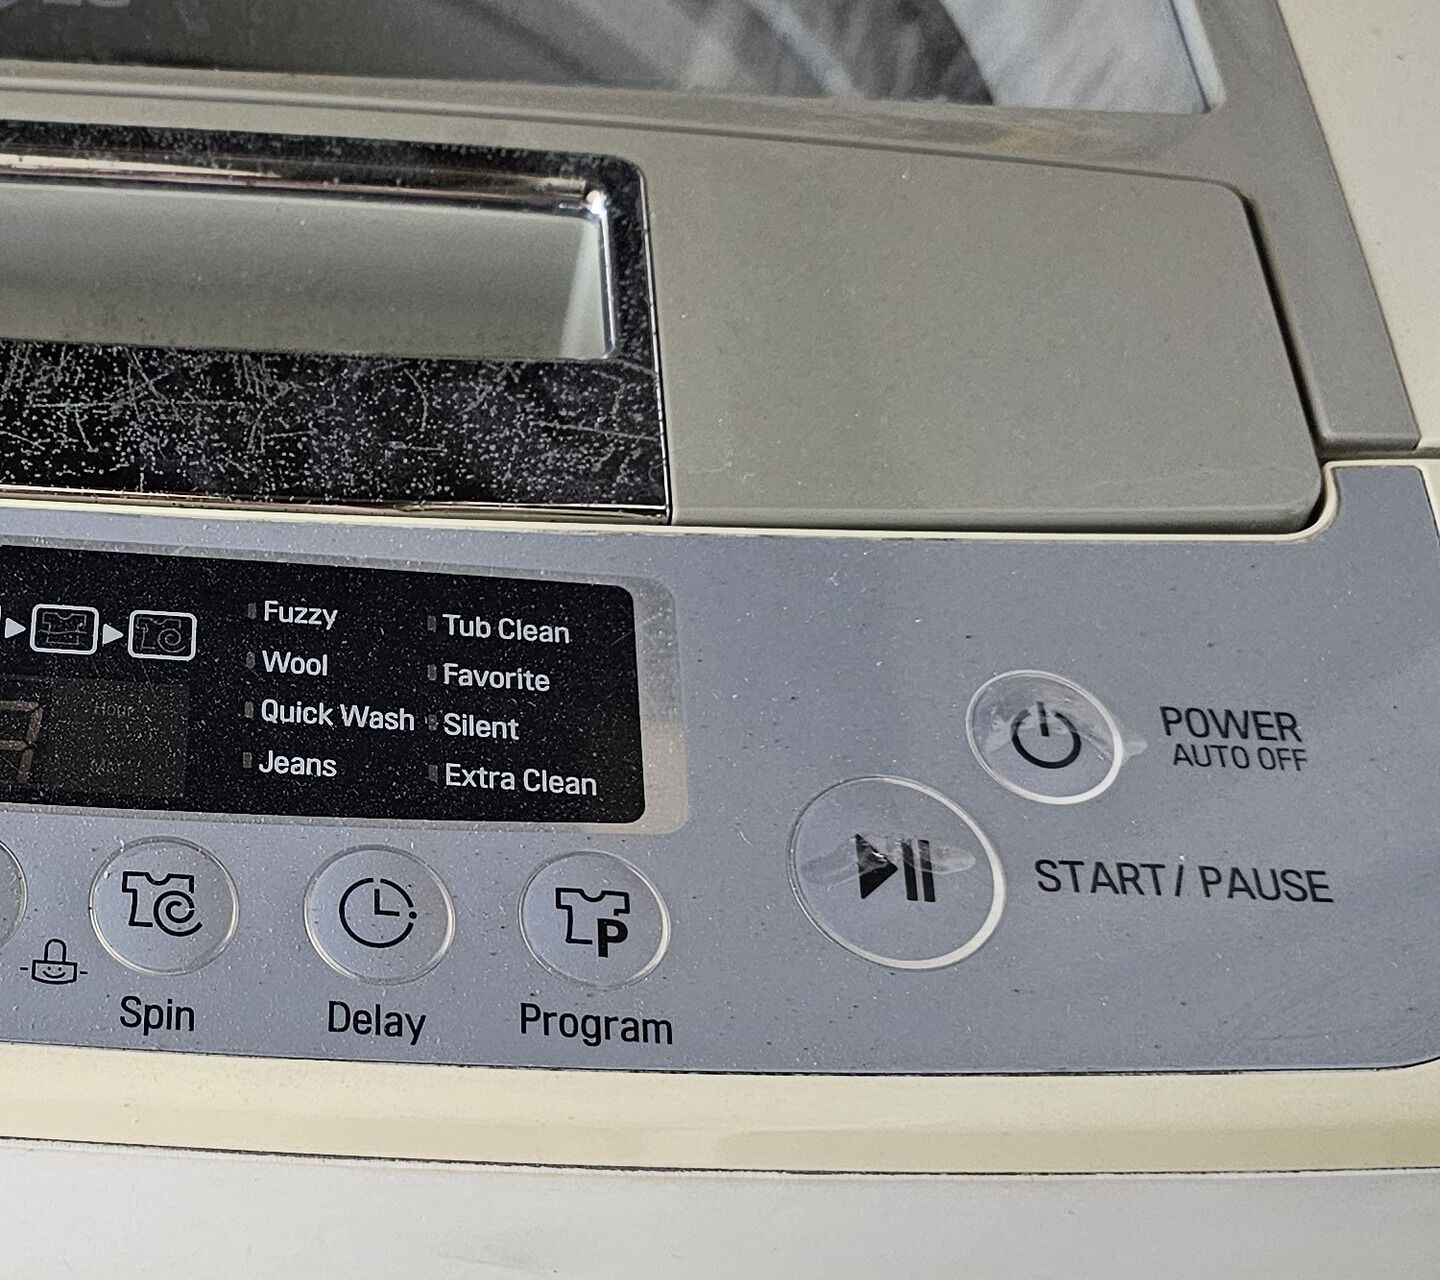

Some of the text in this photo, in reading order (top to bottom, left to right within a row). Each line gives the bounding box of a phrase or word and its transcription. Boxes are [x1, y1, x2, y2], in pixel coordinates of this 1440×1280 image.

[263, 600, 338, 630] Fuzzy
[442, 613, 570, 644] Tub Clean
[262, 650, 328, 676] Wool
[443, 662, 550, 692] Favorite
[261, 699, 415, 732] Quick Wash
[443, 712, 519, 740] Silent
[1159, 705, 1303, 743] POWER
[258, 750, 337, 777] Jeans
[1171, 744, 1308, 773] AUTO OFF
[445, 762, 597, 796] Extra Clean
[1034, 858, 1166, 896] START
[1197, 864, 1335, 904] PAUSE
[120, 995, 195, 1035] Spin
[328, 1002, 427, 1045] Delay
[519, 1003, 674, 1049] Program
